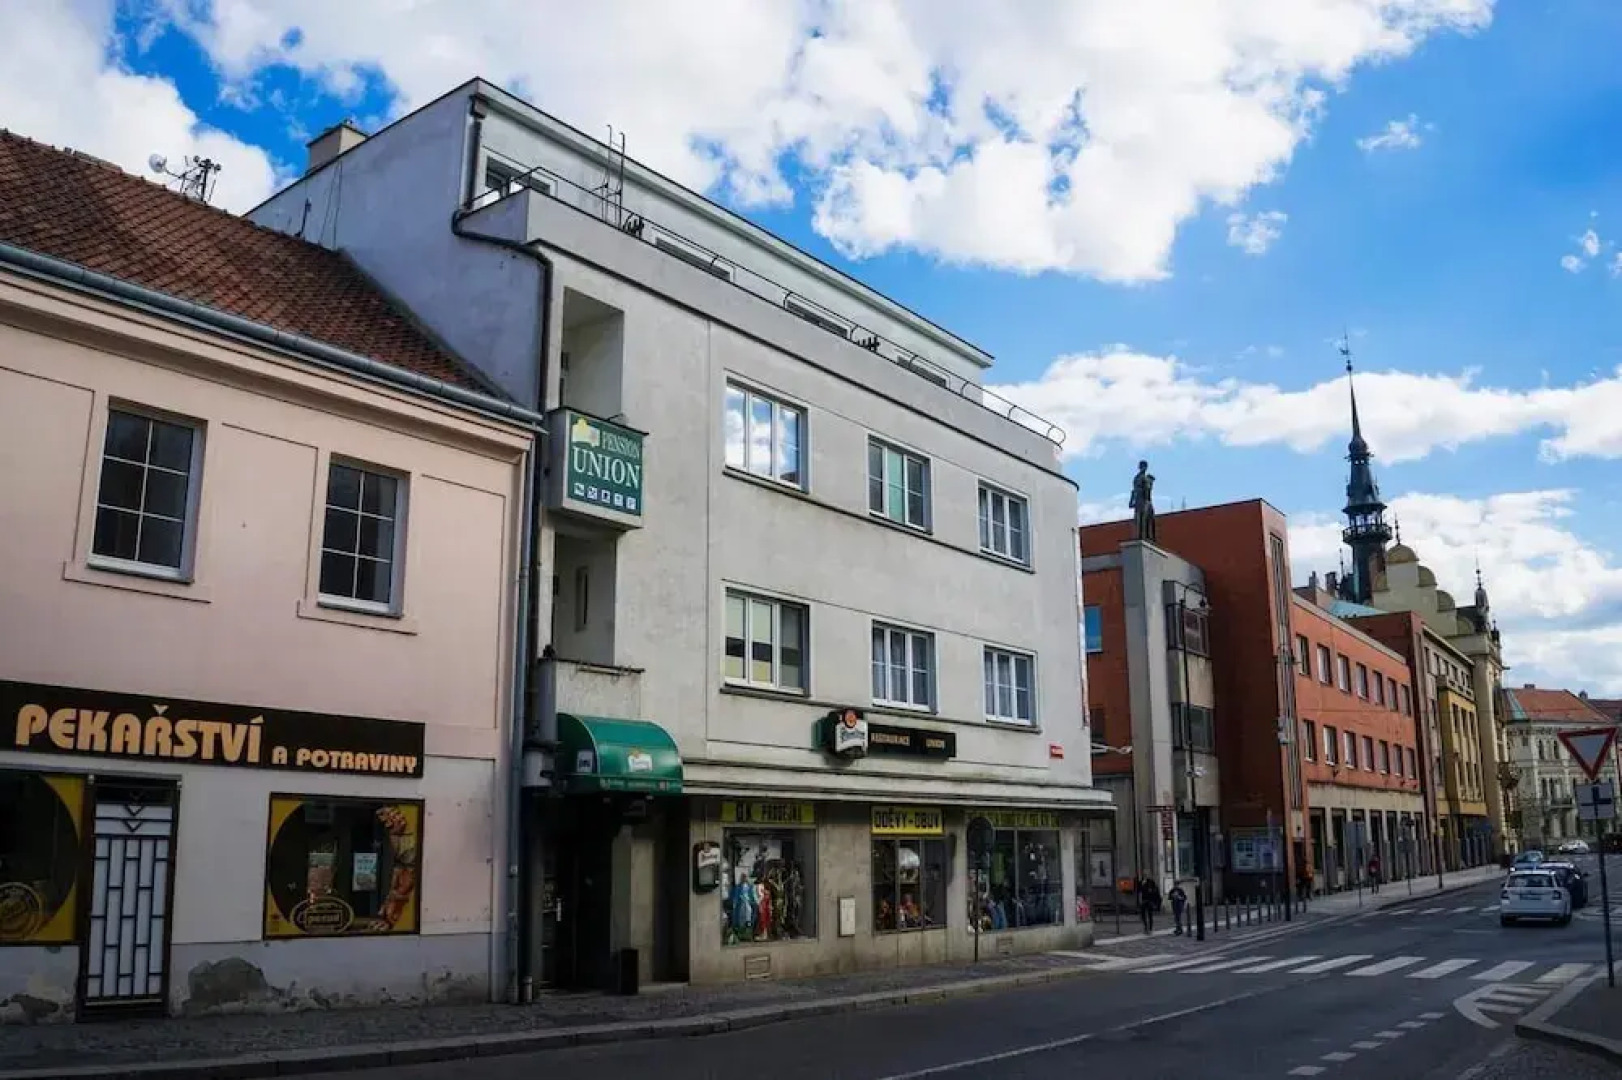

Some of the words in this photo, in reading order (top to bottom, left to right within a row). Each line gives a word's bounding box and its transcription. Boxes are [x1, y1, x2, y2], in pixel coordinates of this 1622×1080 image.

[602, 431, 640, 459] PENSION
[572, 446, 641, 489] UNION
[15, 703, 264, 763] PEKAŘSTVÍ
[272, 746, 287, 765] A
[296, 747, 418, 773] POTRAVINY
